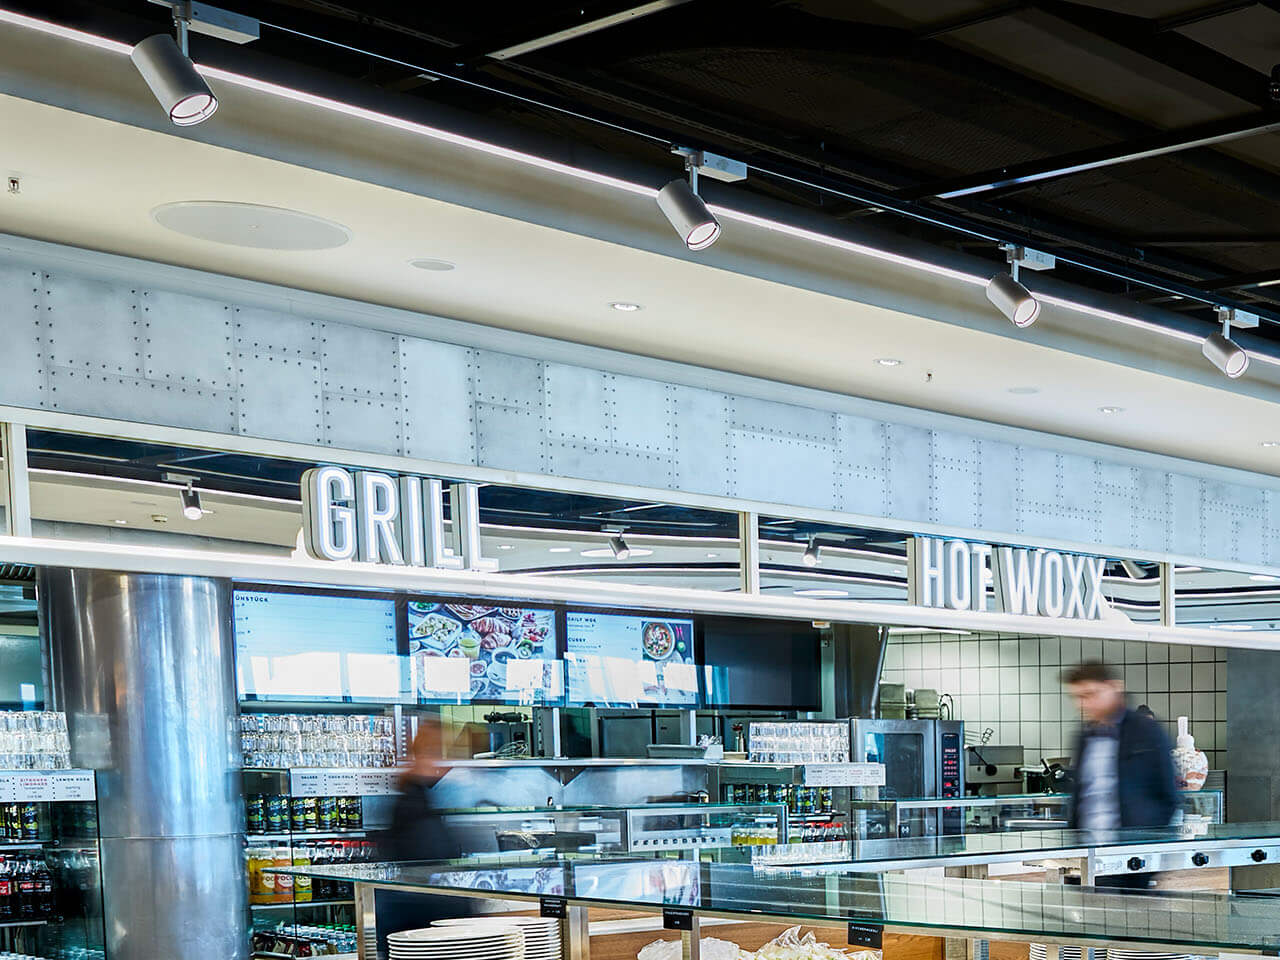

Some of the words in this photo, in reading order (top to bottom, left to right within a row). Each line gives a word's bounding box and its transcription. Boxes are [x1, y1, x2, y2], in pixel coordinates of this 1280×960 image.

[303, 466, 500, 573] GRILL
[235, 594, 269, 603] ÜHSTÜCK
[912, 536, 993, 613] HOT
[1000, 547, 1107, 620] WOXX
